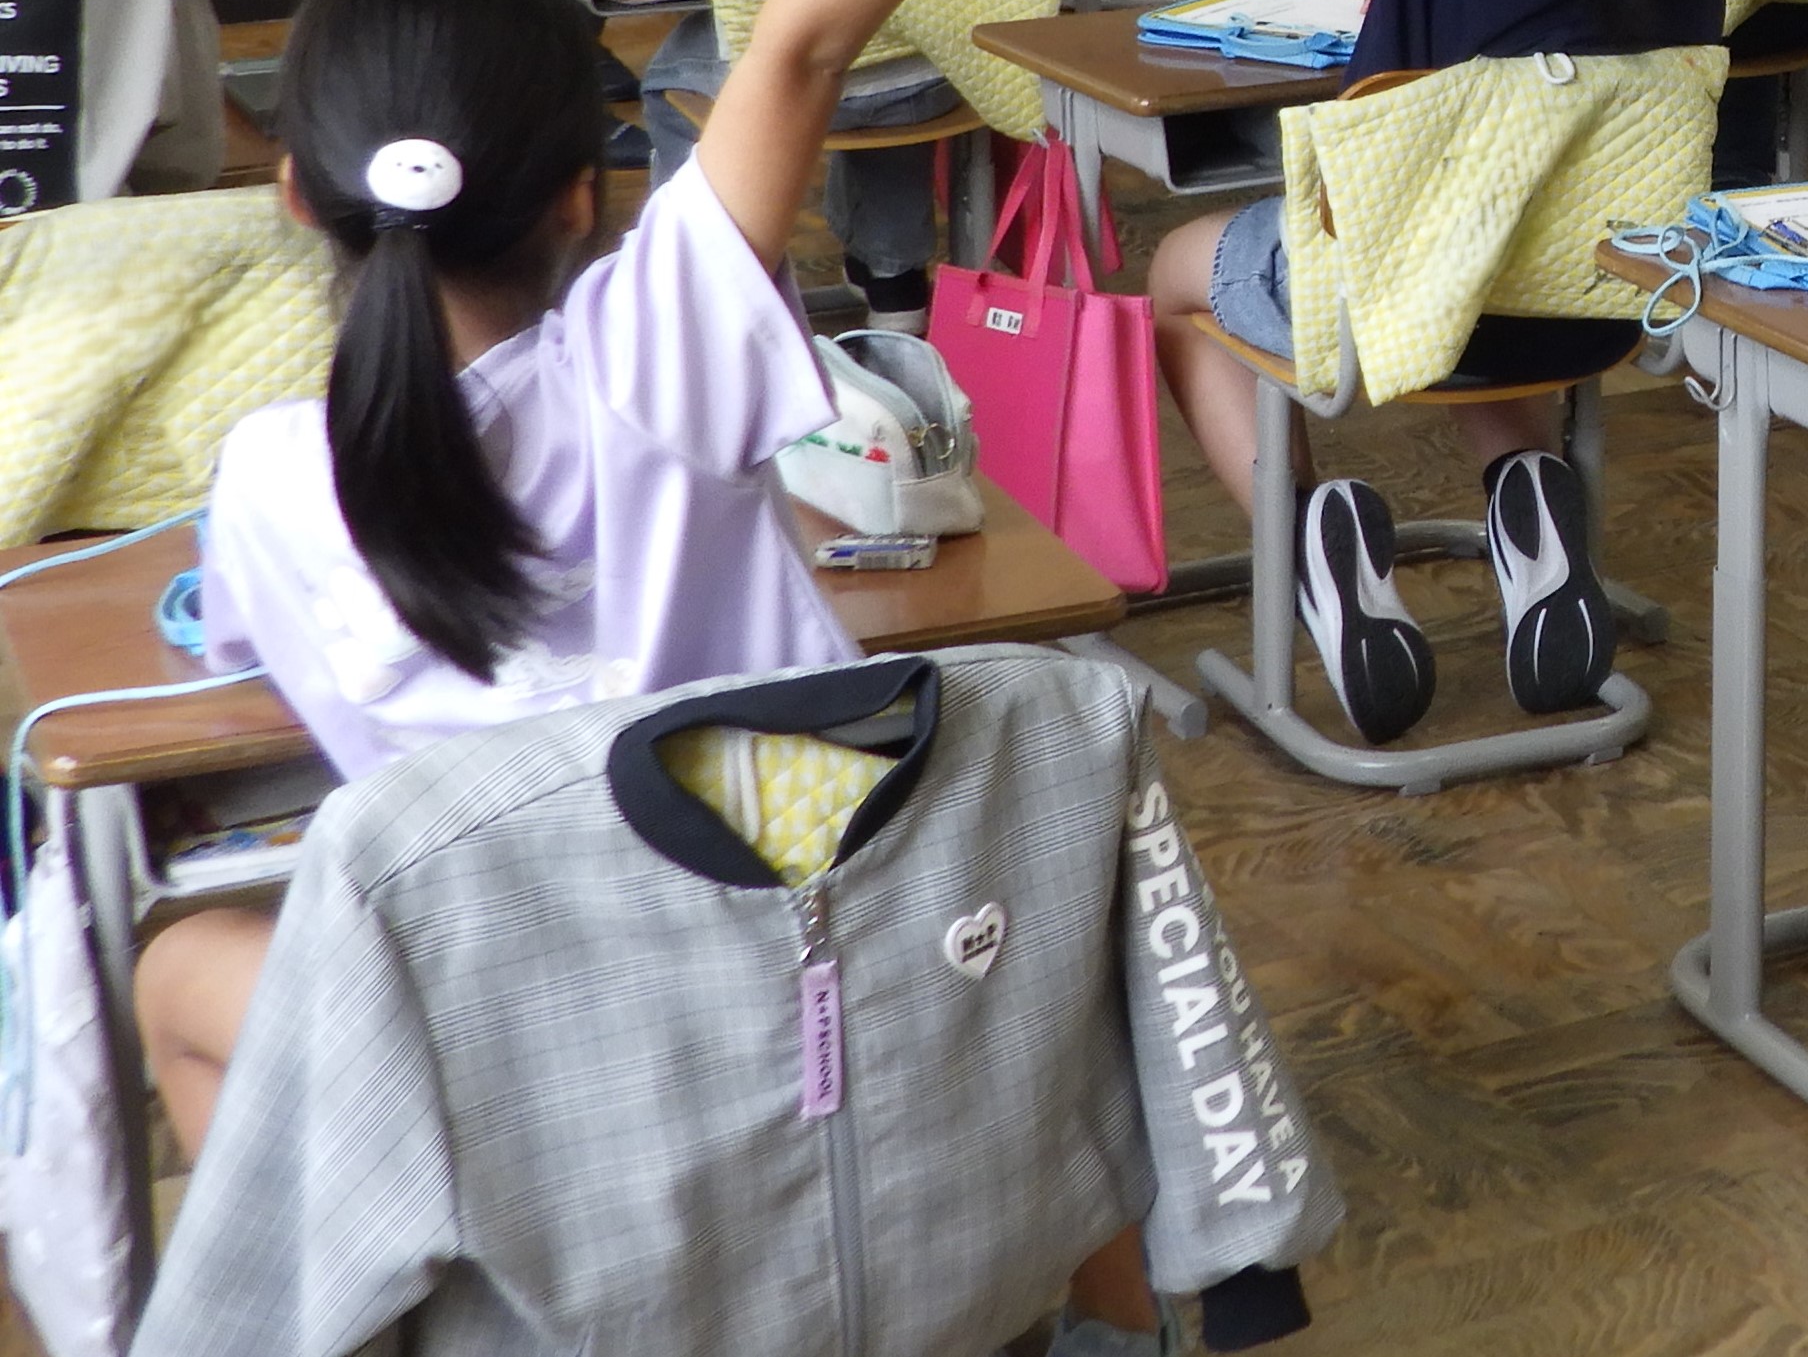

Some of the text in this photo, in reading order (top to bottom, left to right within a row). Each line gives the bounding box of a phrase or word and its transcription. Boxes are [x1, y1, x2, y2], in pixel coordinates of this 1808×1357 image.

[1129, 780, 1273, 1207] SPECIAL DAY
[1240, 1020, 1296, 1152] HAVE
[1279, 1155, 1310, 1195] A
